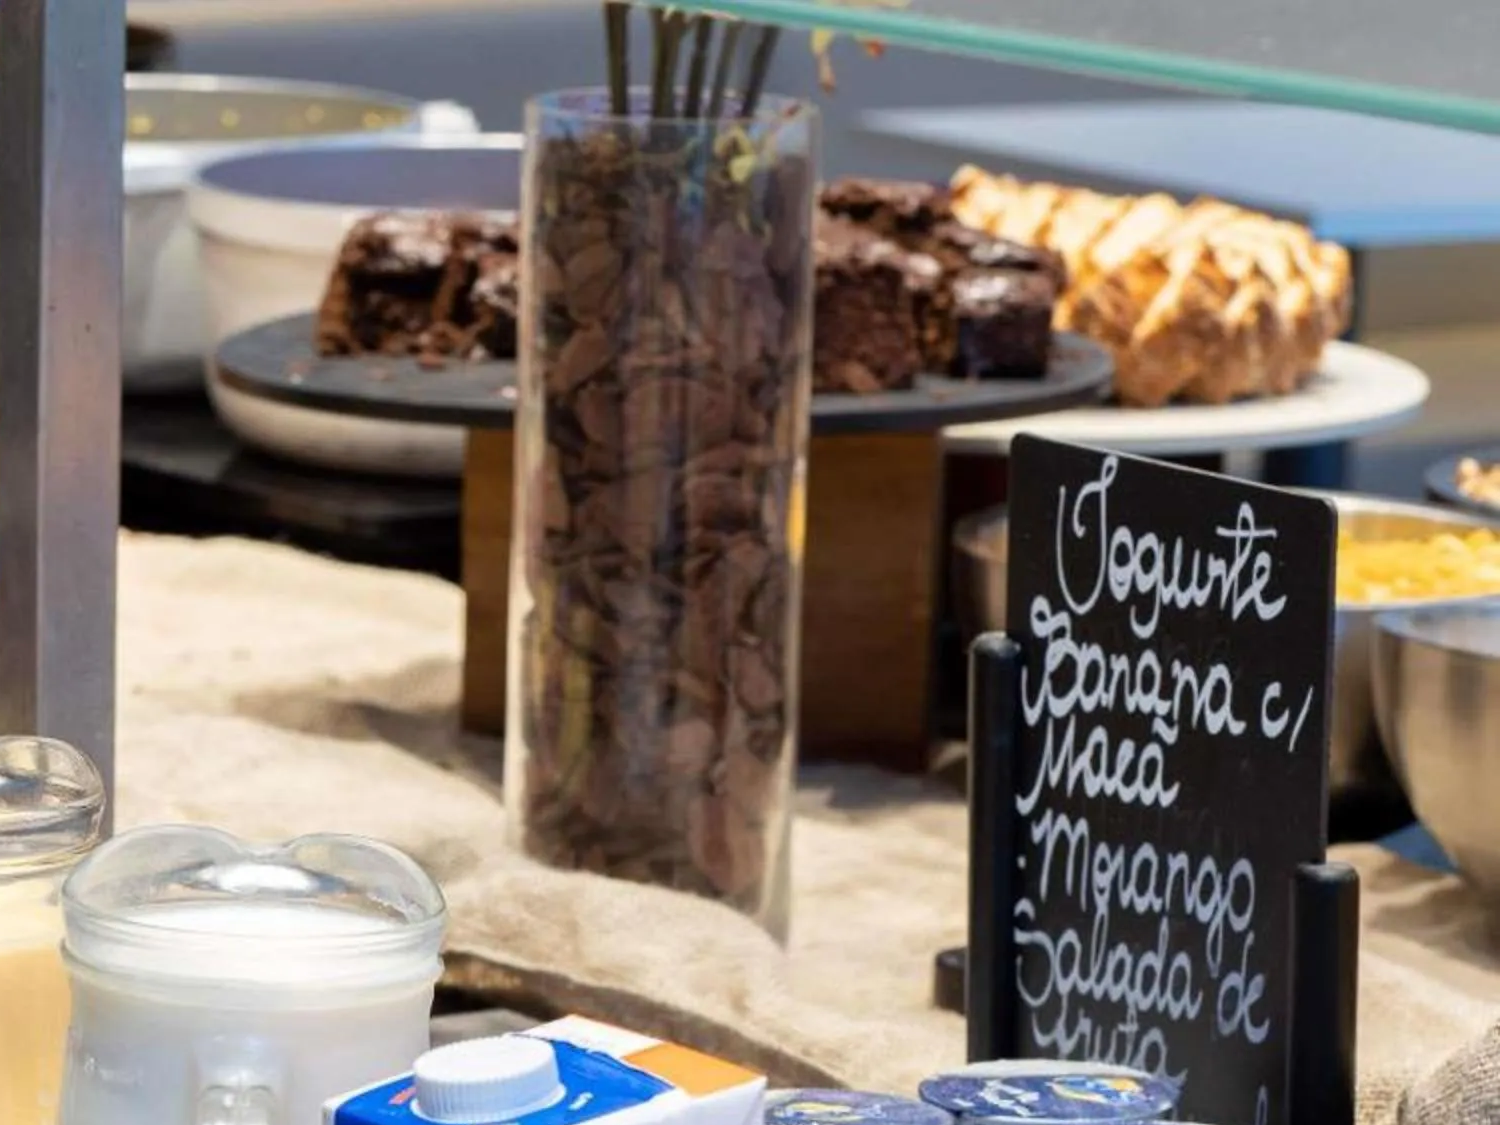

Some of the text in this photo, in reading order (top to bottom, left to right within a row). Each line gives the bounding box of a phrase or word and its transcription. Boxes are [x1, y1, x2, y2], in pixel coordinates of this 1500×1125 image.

[1021, 595, 1247, 736] Banana
[1031, 808, 1255, 978] Morango
[1014, 898, 1269, 1043] Salada de
